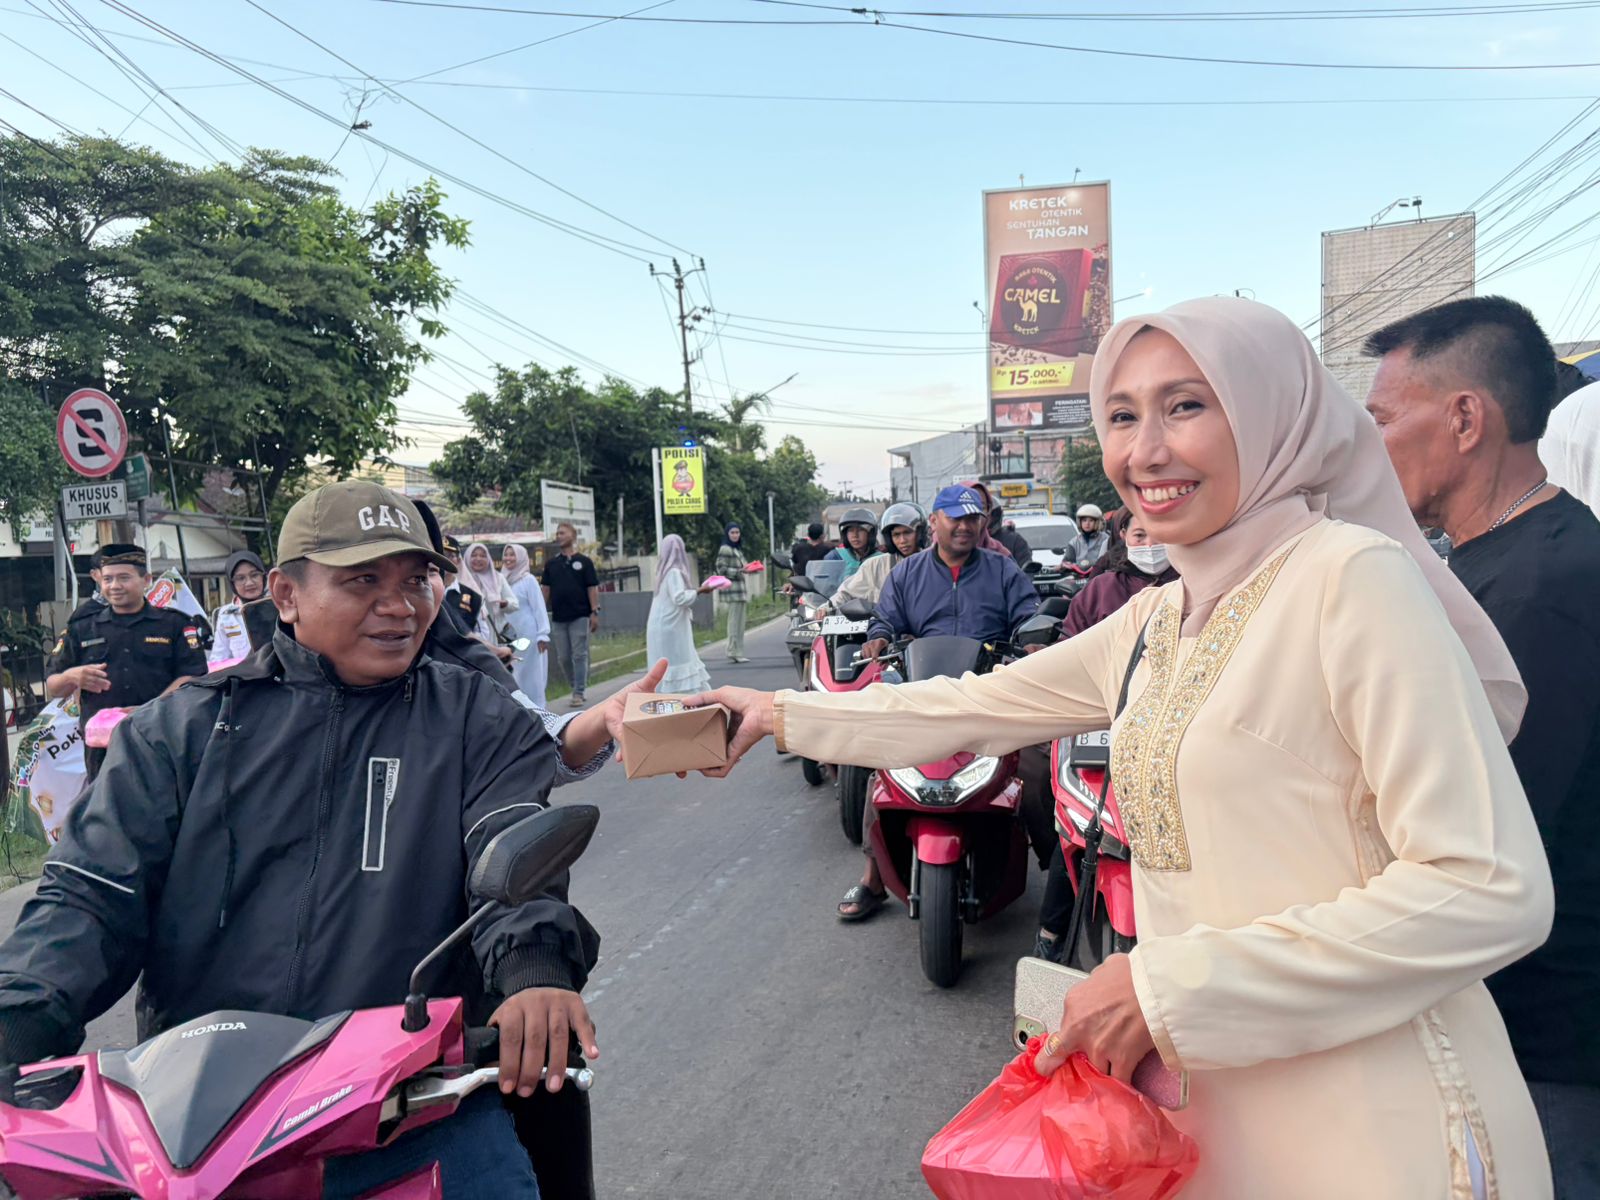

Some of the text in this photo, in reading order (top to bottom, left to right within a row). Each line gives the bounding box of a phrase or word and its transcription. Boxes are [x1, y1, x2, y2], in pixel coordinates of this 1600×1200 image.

[1009, 196, 1067, 211] KRETEK
[1041, 208, 1082, 218] OTENTIK
[1007, 218, 1060, 230] SENTUHAN
[1027, 225, 1088, 240] TANGAN
[1005, 288, 1061, 304] CAMEL
[664, 448, 699, 459] POLISI
[69, 486, 118, 502] KHUSUS
[79, 501, 111, 516] TRUK
[358, 505, 410, 534] GAP
[1080, 733, 1089, 745] B
[181, 1022, 247, 1039] HONDA
[283, 1085, 353, 1130] Combi Brake
